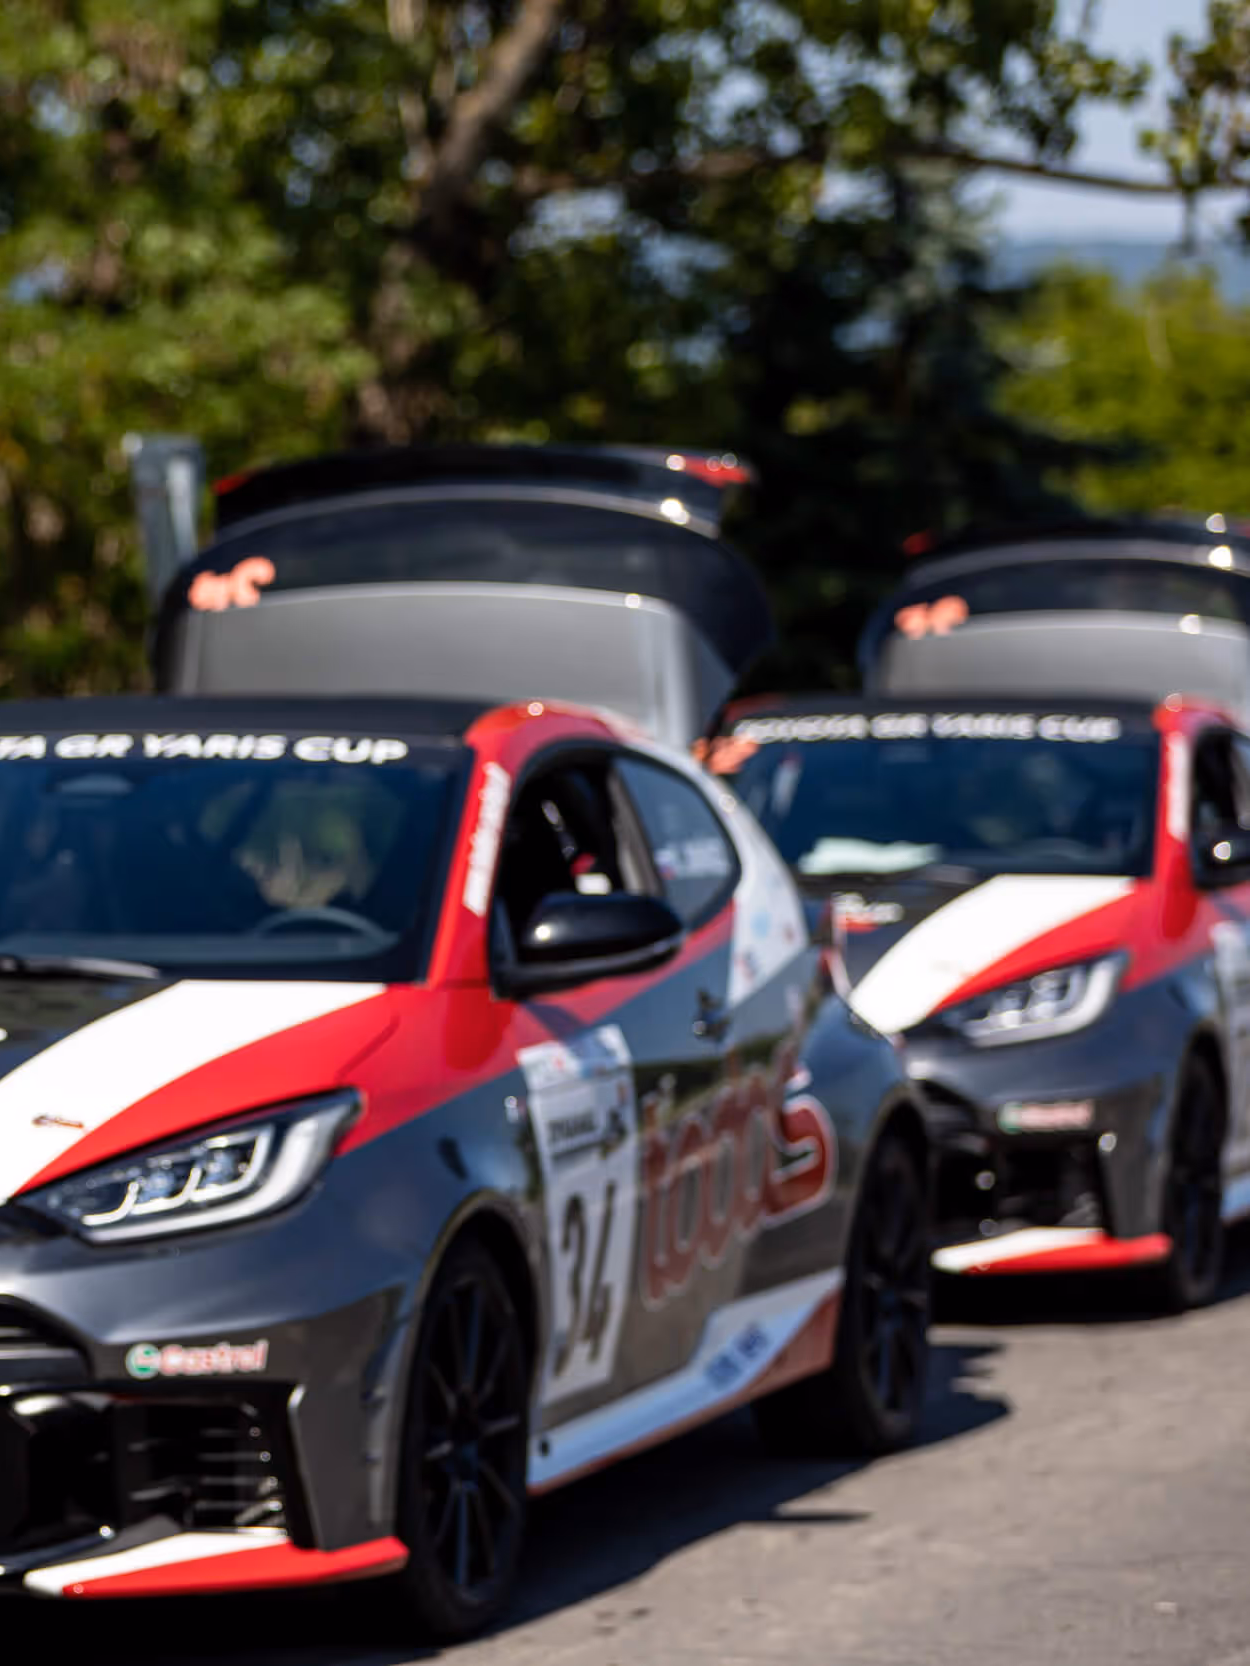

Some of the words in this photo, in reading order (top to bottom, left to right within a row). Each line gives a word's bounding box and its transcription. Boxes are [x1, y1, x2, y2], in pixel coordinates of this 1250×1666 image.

[54, 733, 135, 759] GR
[143, 733, 288, 761] YARIS
[293, 735, 409, 765] CUP
